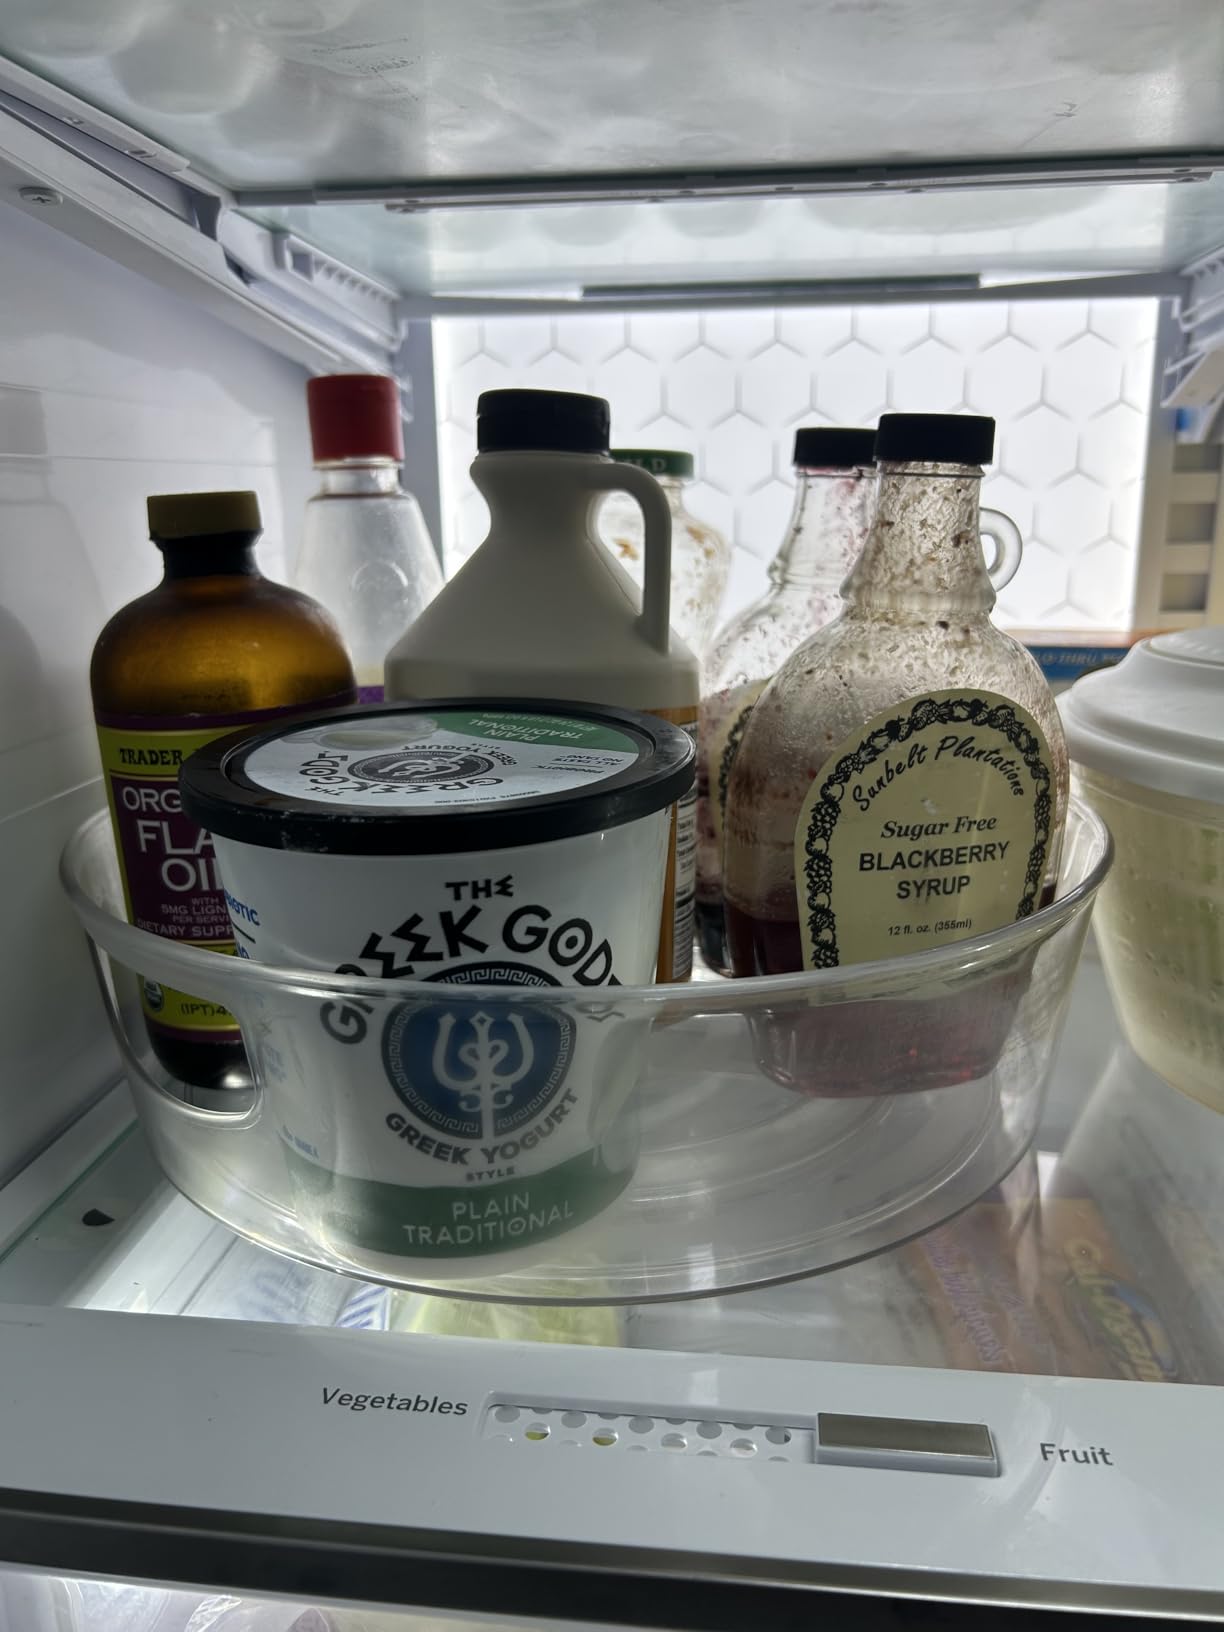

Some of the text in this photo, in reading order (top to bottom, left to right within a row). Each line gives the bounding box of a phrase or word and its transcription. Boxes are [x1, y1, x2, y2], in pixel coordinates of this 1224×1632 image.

[469, 719, 584, 740] TRADITIONAL
[484, 729, 541, 741] PLAIN
[120, 748, 183, 766] TRADER
[852, 735, 1025, 812] Sunbelt Plantations
[880, 815, 997, 841] Sugar Free
[858, 841, 1011, 871] BLACKBERRY
[161, 857, 224, 893] OIL
[444, 874, 514, 901] THE
[896, 875, 971, 900] SYRUP
[191, 897, 219, 905] WITH
[192, 904, 227, 915] LIGN
[172, 914, 193, 923] PER
[887, 919, 973, 936] 12 fl. oz. (355ml)
[385, 1111, 472, 1166] GREEK
[480, 1088, 579, 1165] YOGURT
[466, 1165, 515, 1181] STYLE
[452, 1191, 530, 1222] PLAIN
[403, 1199, 574, 1246] TRADITIONAL
[322, 1387, 469, 1416] Vegetables
[1040, 1442, 1114, 1466] Fruit
